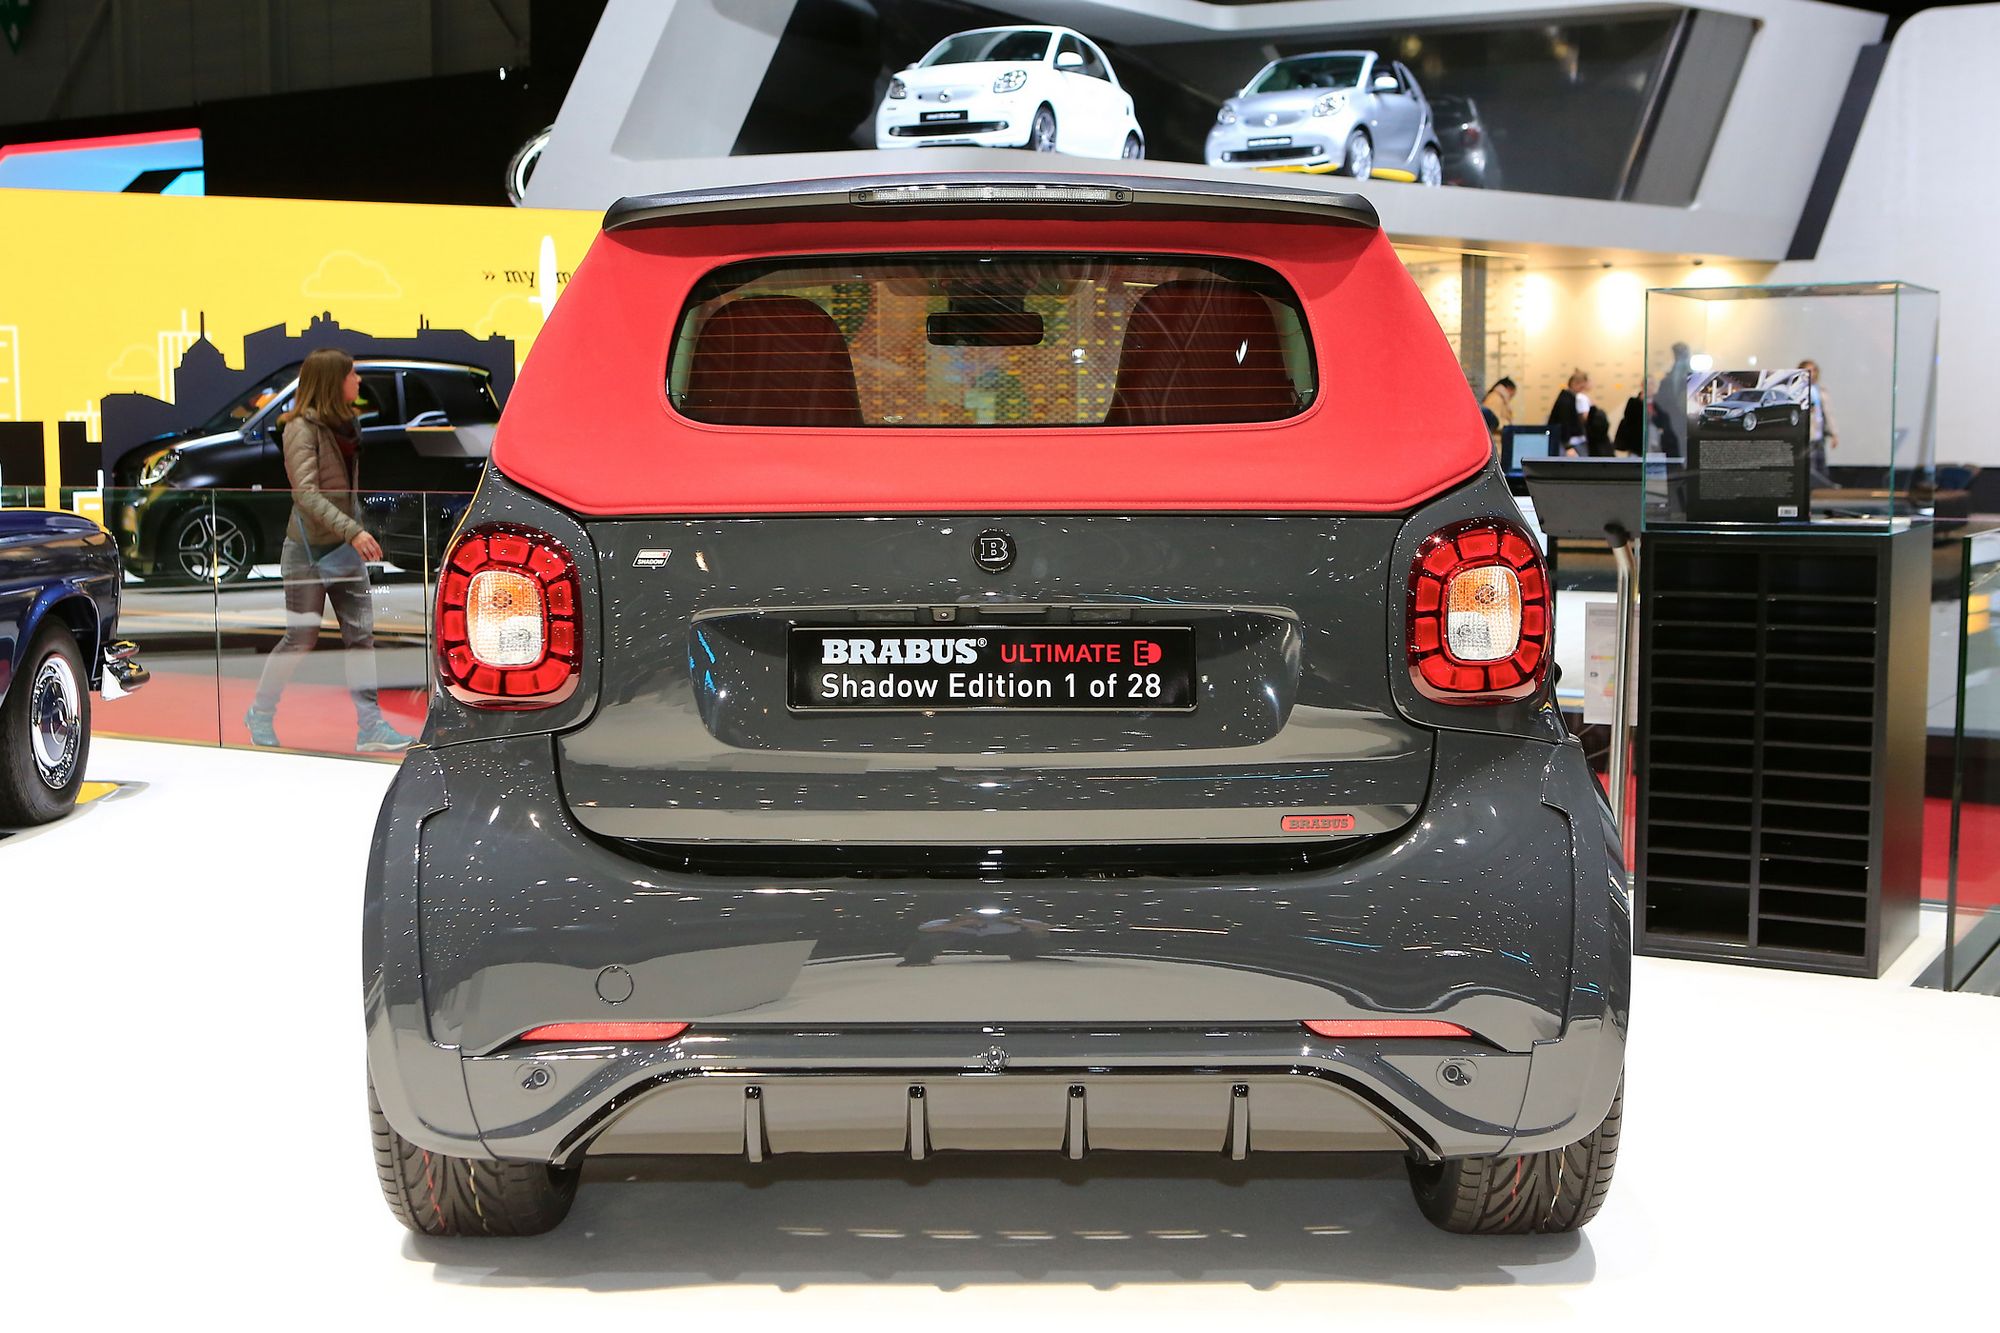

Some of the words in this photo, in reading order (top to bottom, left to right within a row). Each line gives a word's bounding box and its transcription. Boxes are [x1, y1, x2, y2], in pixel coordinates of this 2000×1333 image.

[980, 537, 1009, 562] B
[1001, 643, 1121, 663] ULTIMATE
[821, 673, 939, 699] Shadow
[949, 673, 1052, 698] Edition
[1064, 673, 1076, 698] 1
[1089, 673, 1118, 698] of
[1127, 673, 1162, 698] 28
[1289, 819, 1349, 830] BRABUS
